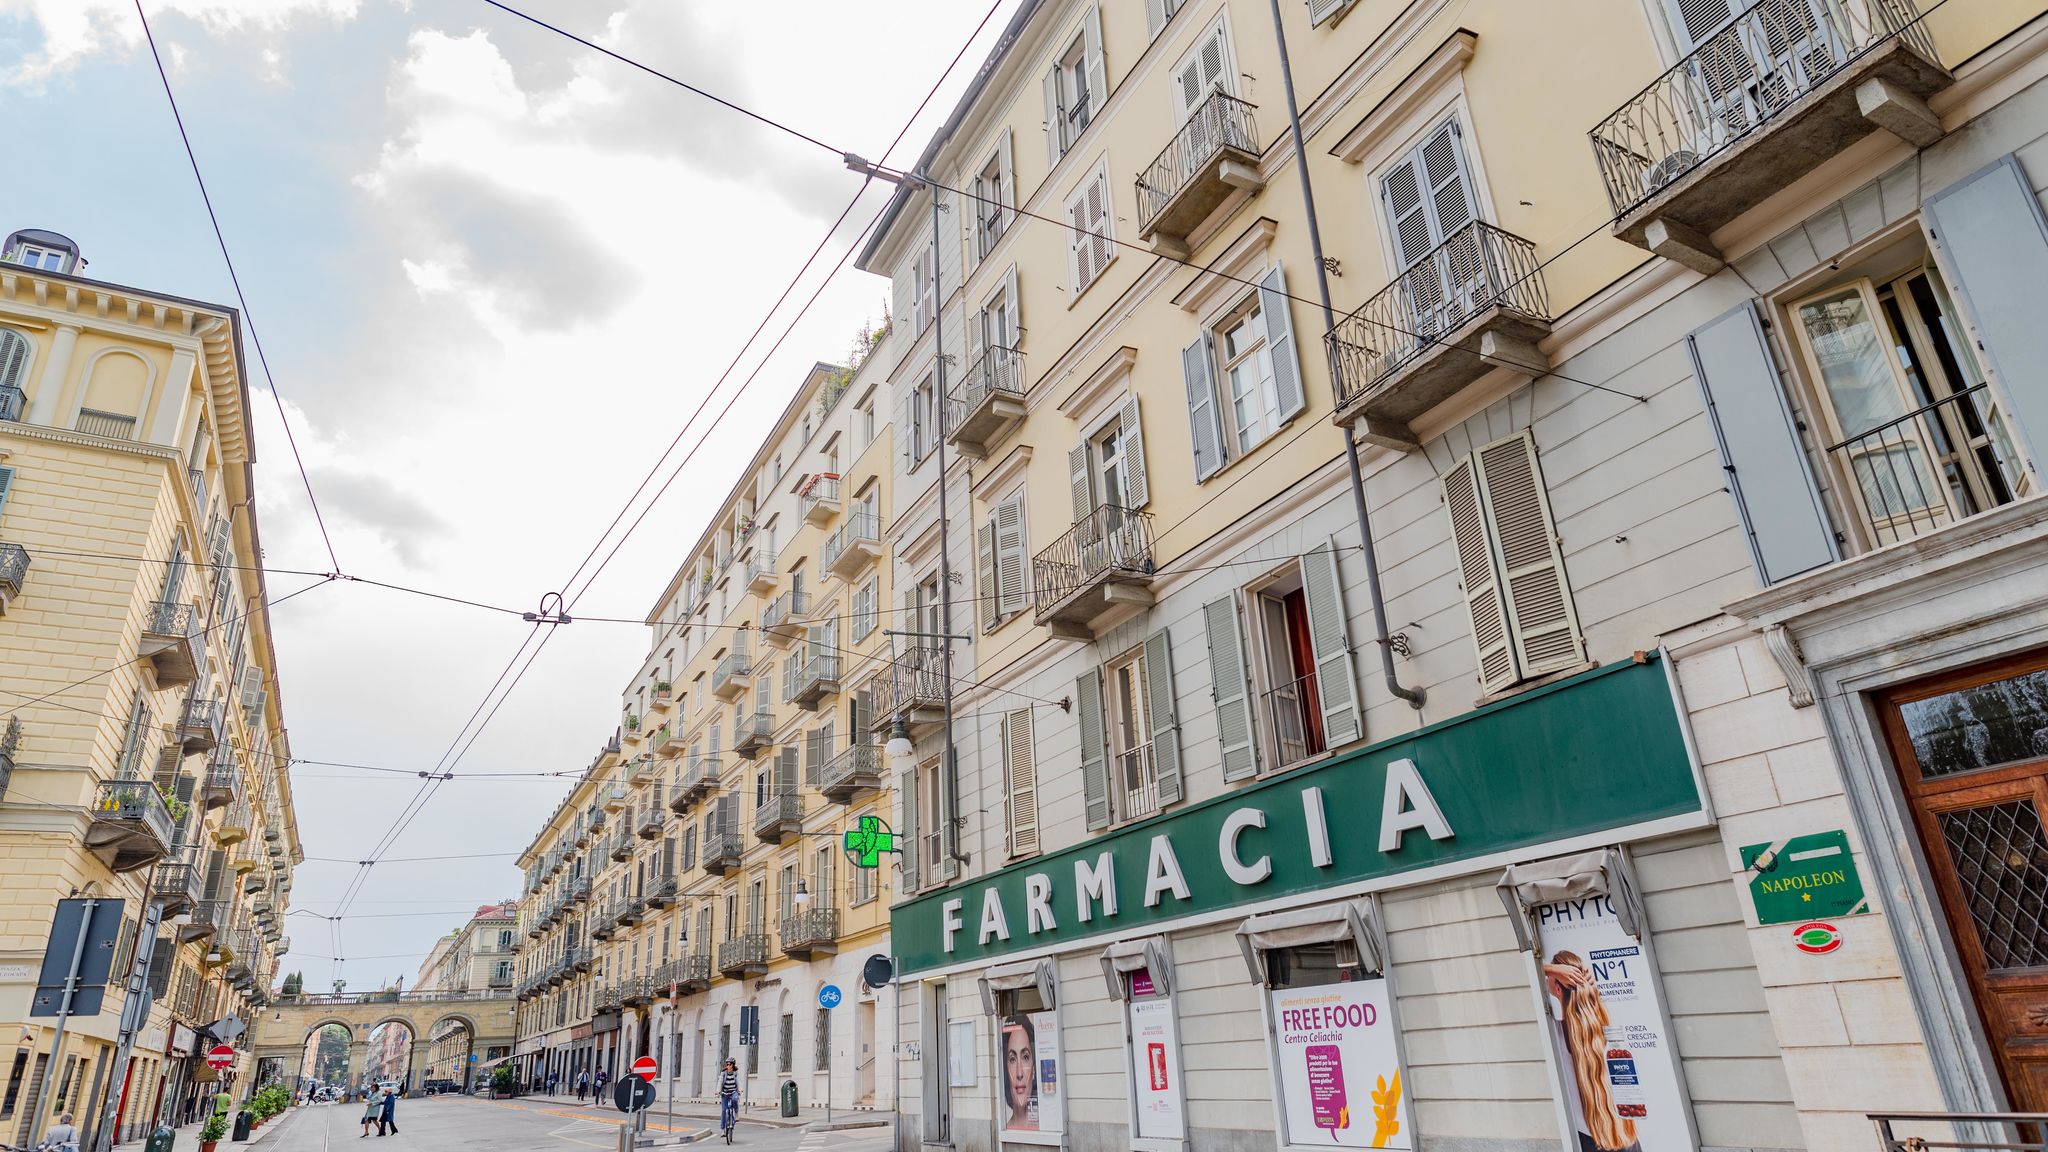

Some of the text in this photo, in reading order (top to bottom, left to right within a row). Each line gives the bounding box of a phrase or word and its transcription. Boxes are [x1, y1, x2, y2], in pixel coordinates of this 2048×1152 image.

[942, 757, 1455, 953] FARMACIA
[1761, 870, 1846, 894] NAPOLEON
[1591, 948, 1638, 959] PHYTOPHANERE
[1592, 960, 1628, 981] N°1
[1599, 989, 1634, 997] ALIMENTARE
[1281, 994, 1342, 1007] alimenti senza glutine
[1285, 1031, 1343, 1044] Centro Celiachia
